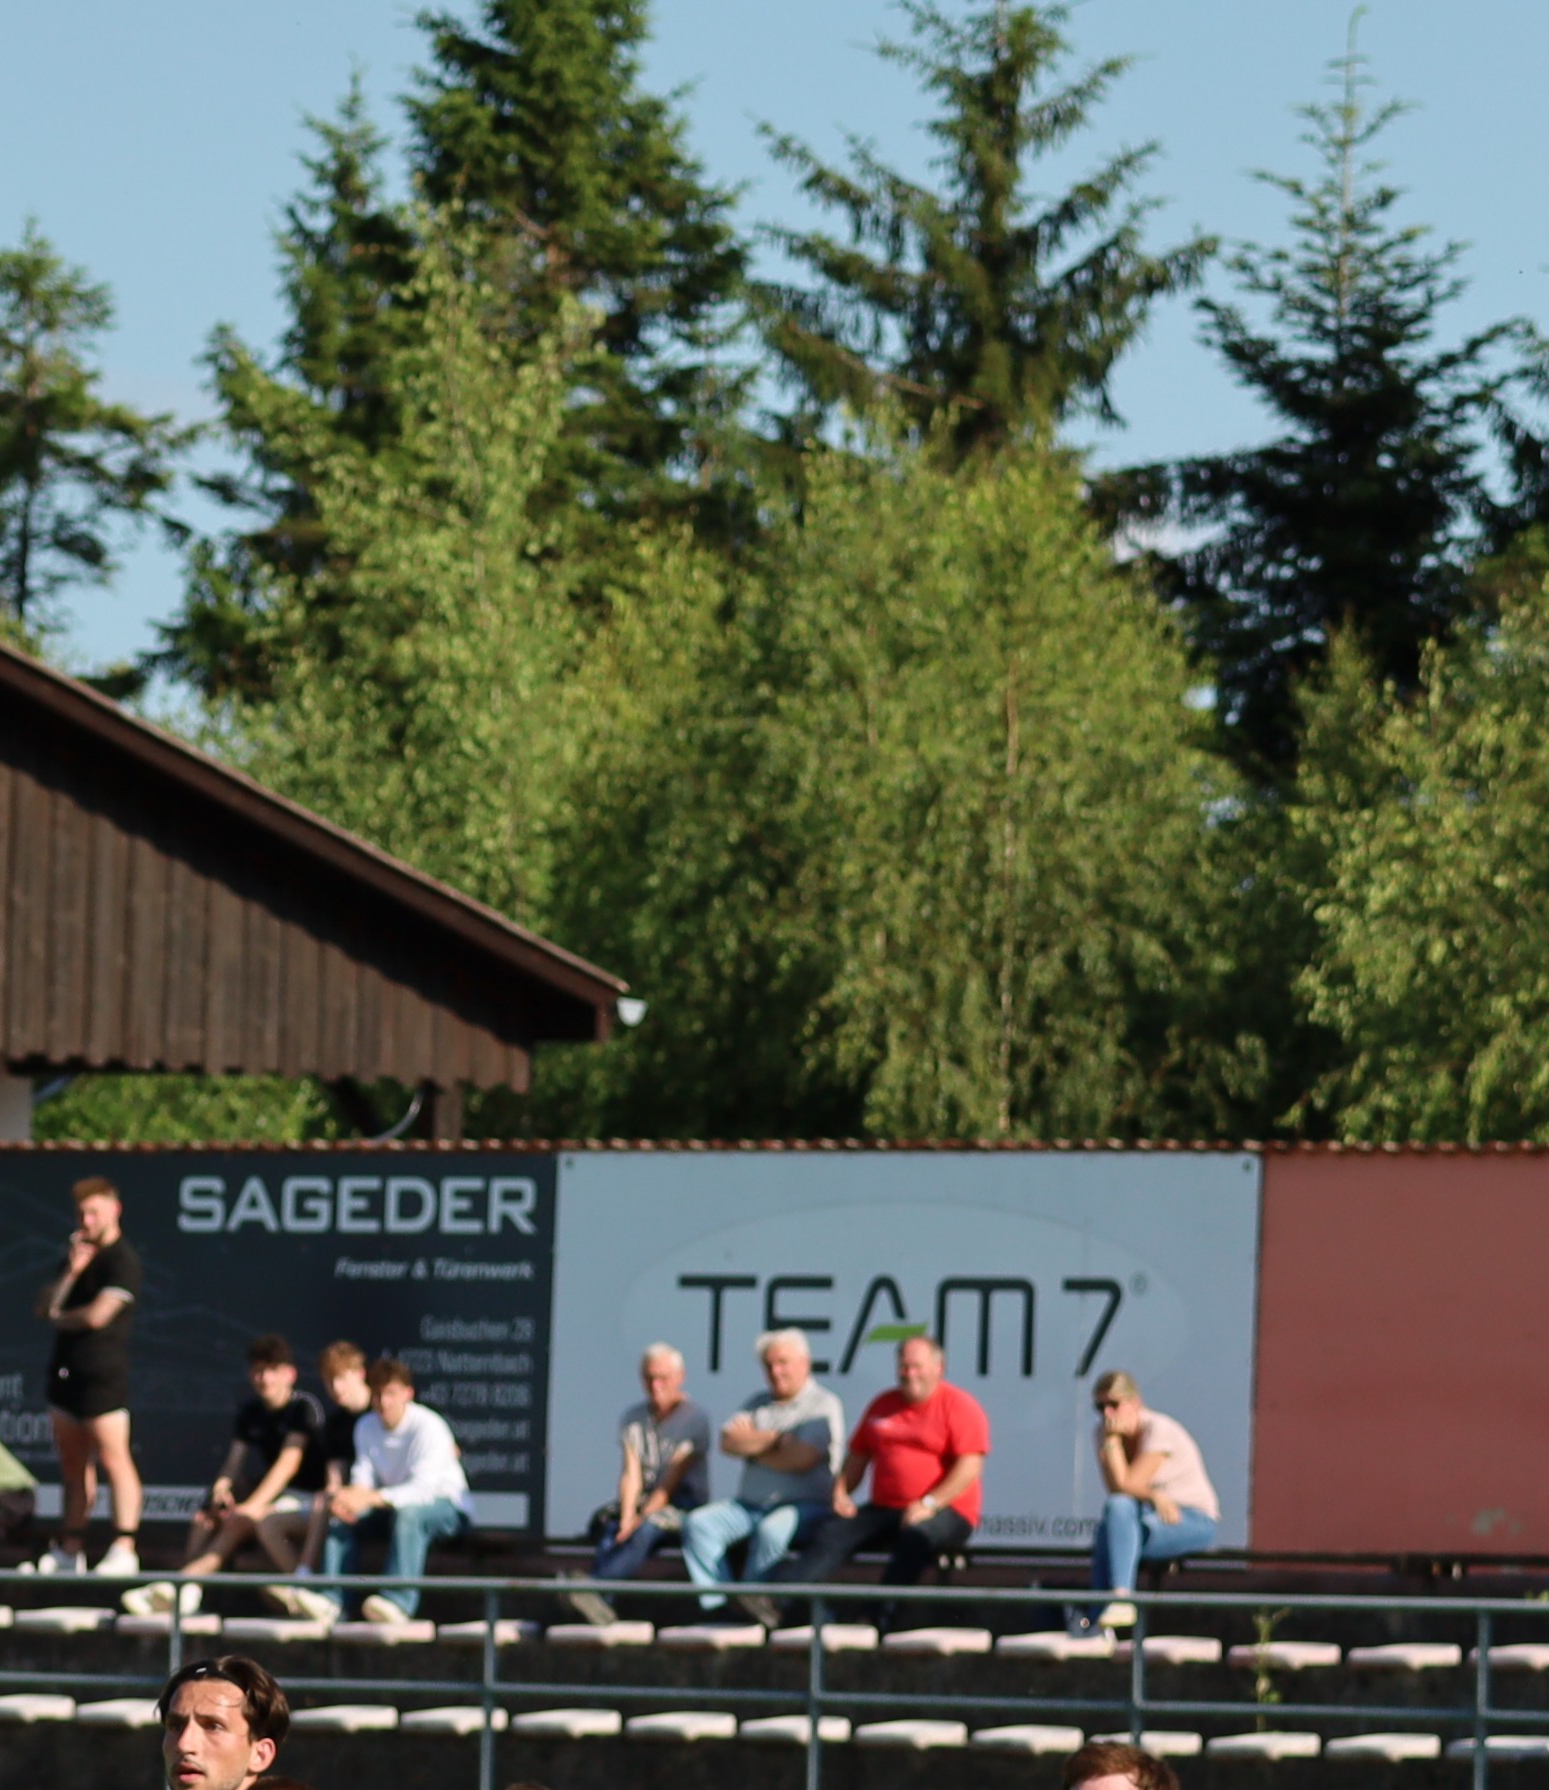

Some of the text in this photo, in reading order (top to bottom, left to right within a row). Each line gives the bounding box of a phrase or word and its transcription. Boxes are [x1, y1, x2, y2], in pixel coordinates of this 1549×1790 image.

[177, 1175, 538, 1235] SAGEDER
[334, 1257, 405, 1280] Fenster
[411, 1258, 427, 1280] &
[678, 1275, 1036, 1377] TEAM
